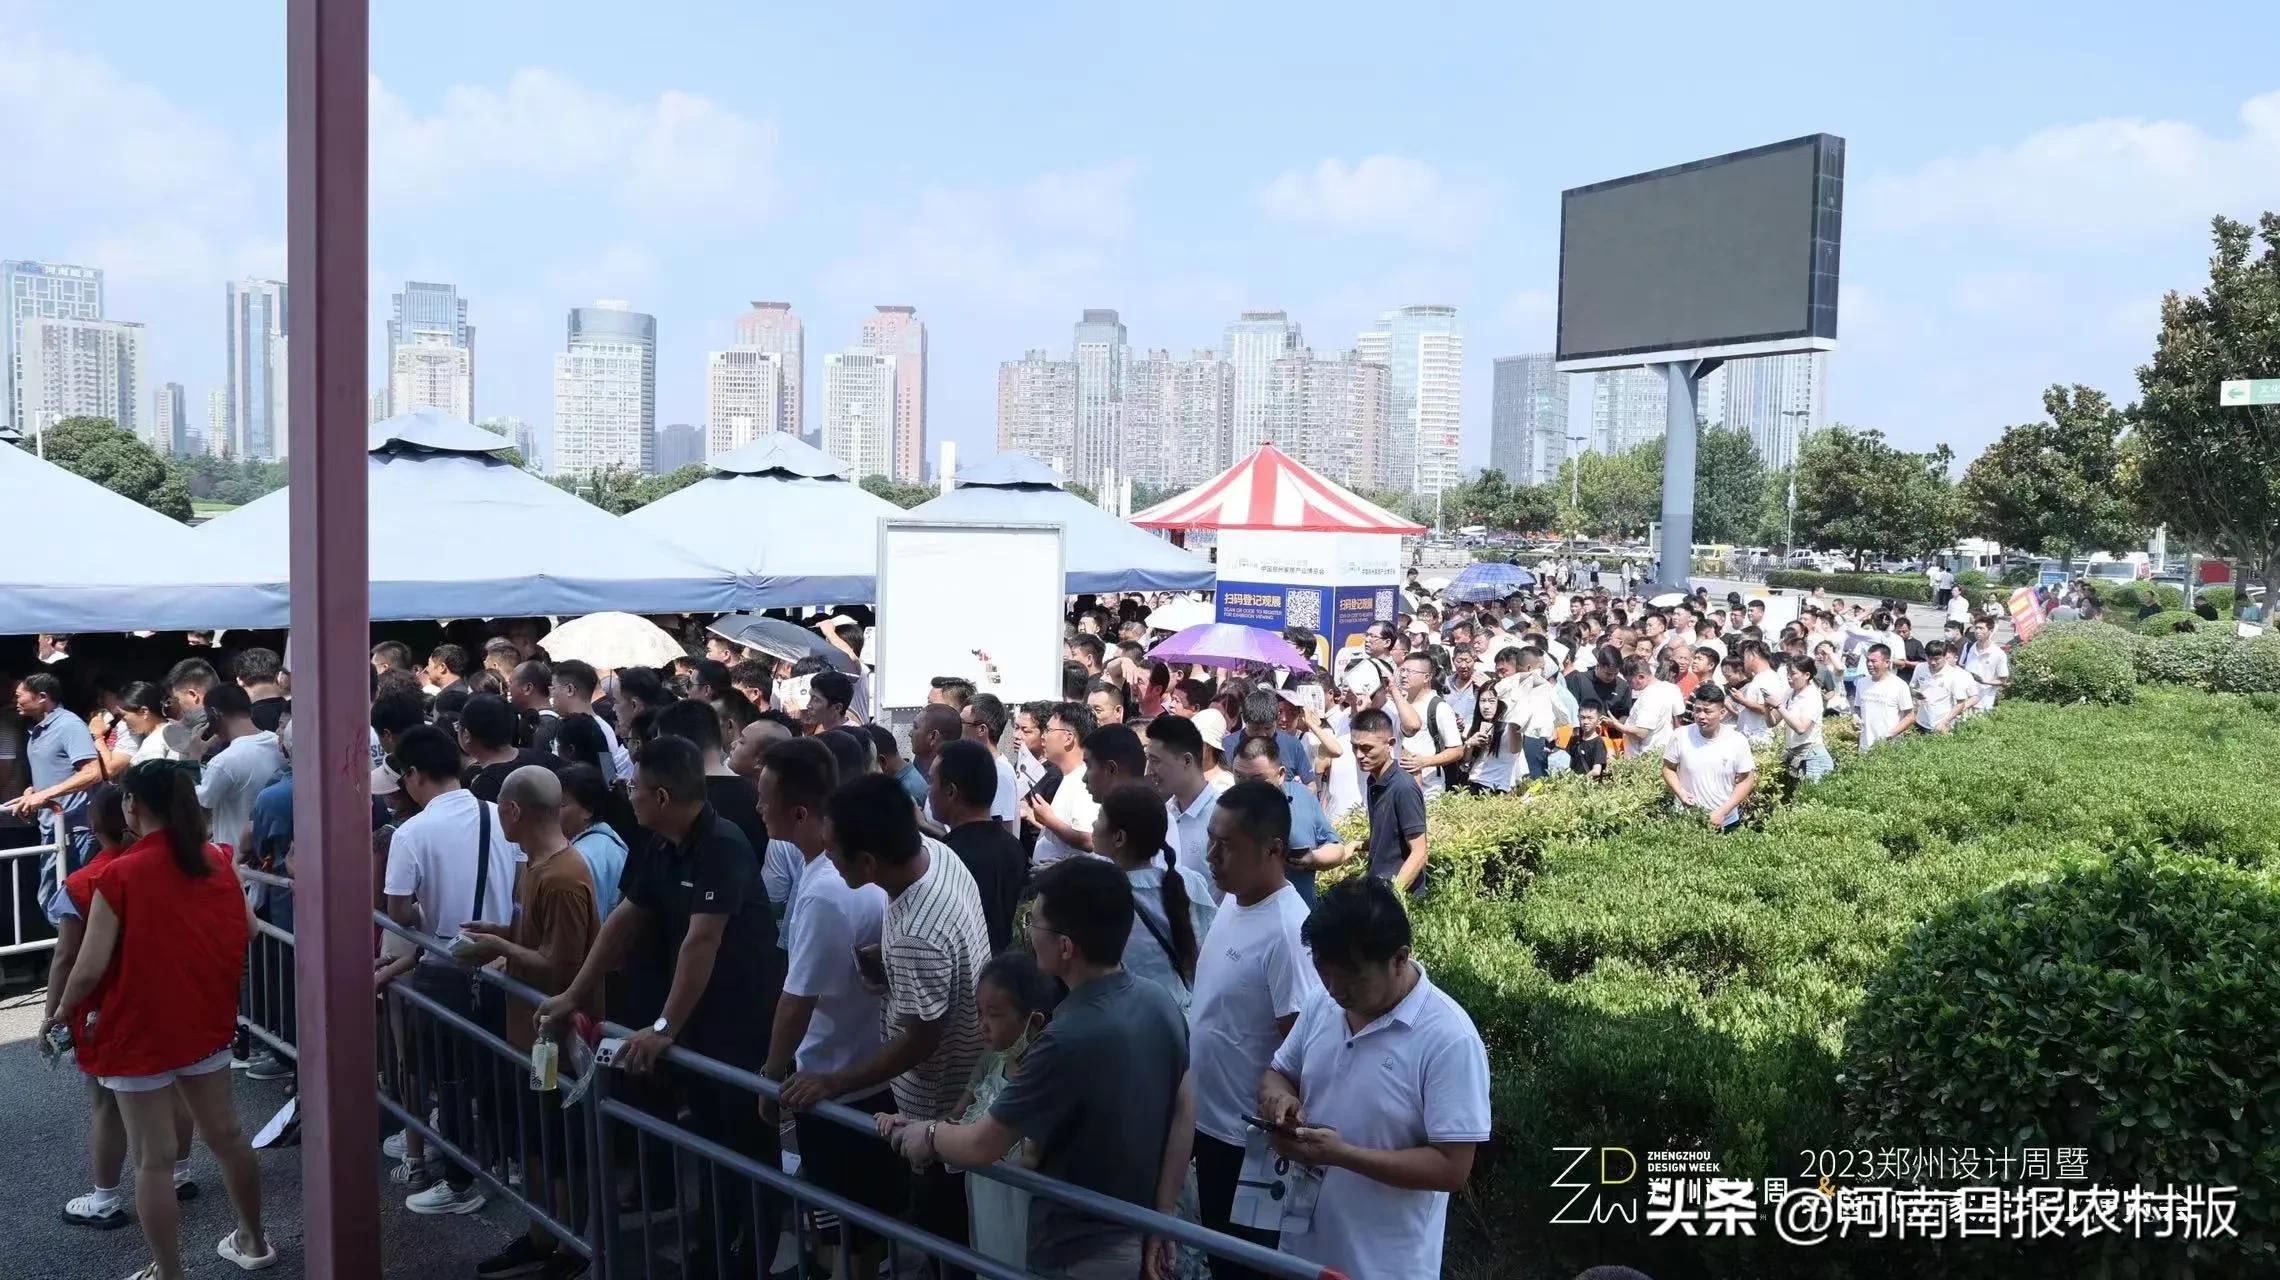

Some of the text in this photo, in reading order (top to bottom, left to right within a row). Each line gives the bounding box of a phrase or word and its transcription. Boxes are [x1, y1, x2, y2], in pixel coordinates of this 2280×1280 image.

[1224, 592, 1282, 608] 扫码登记观展
